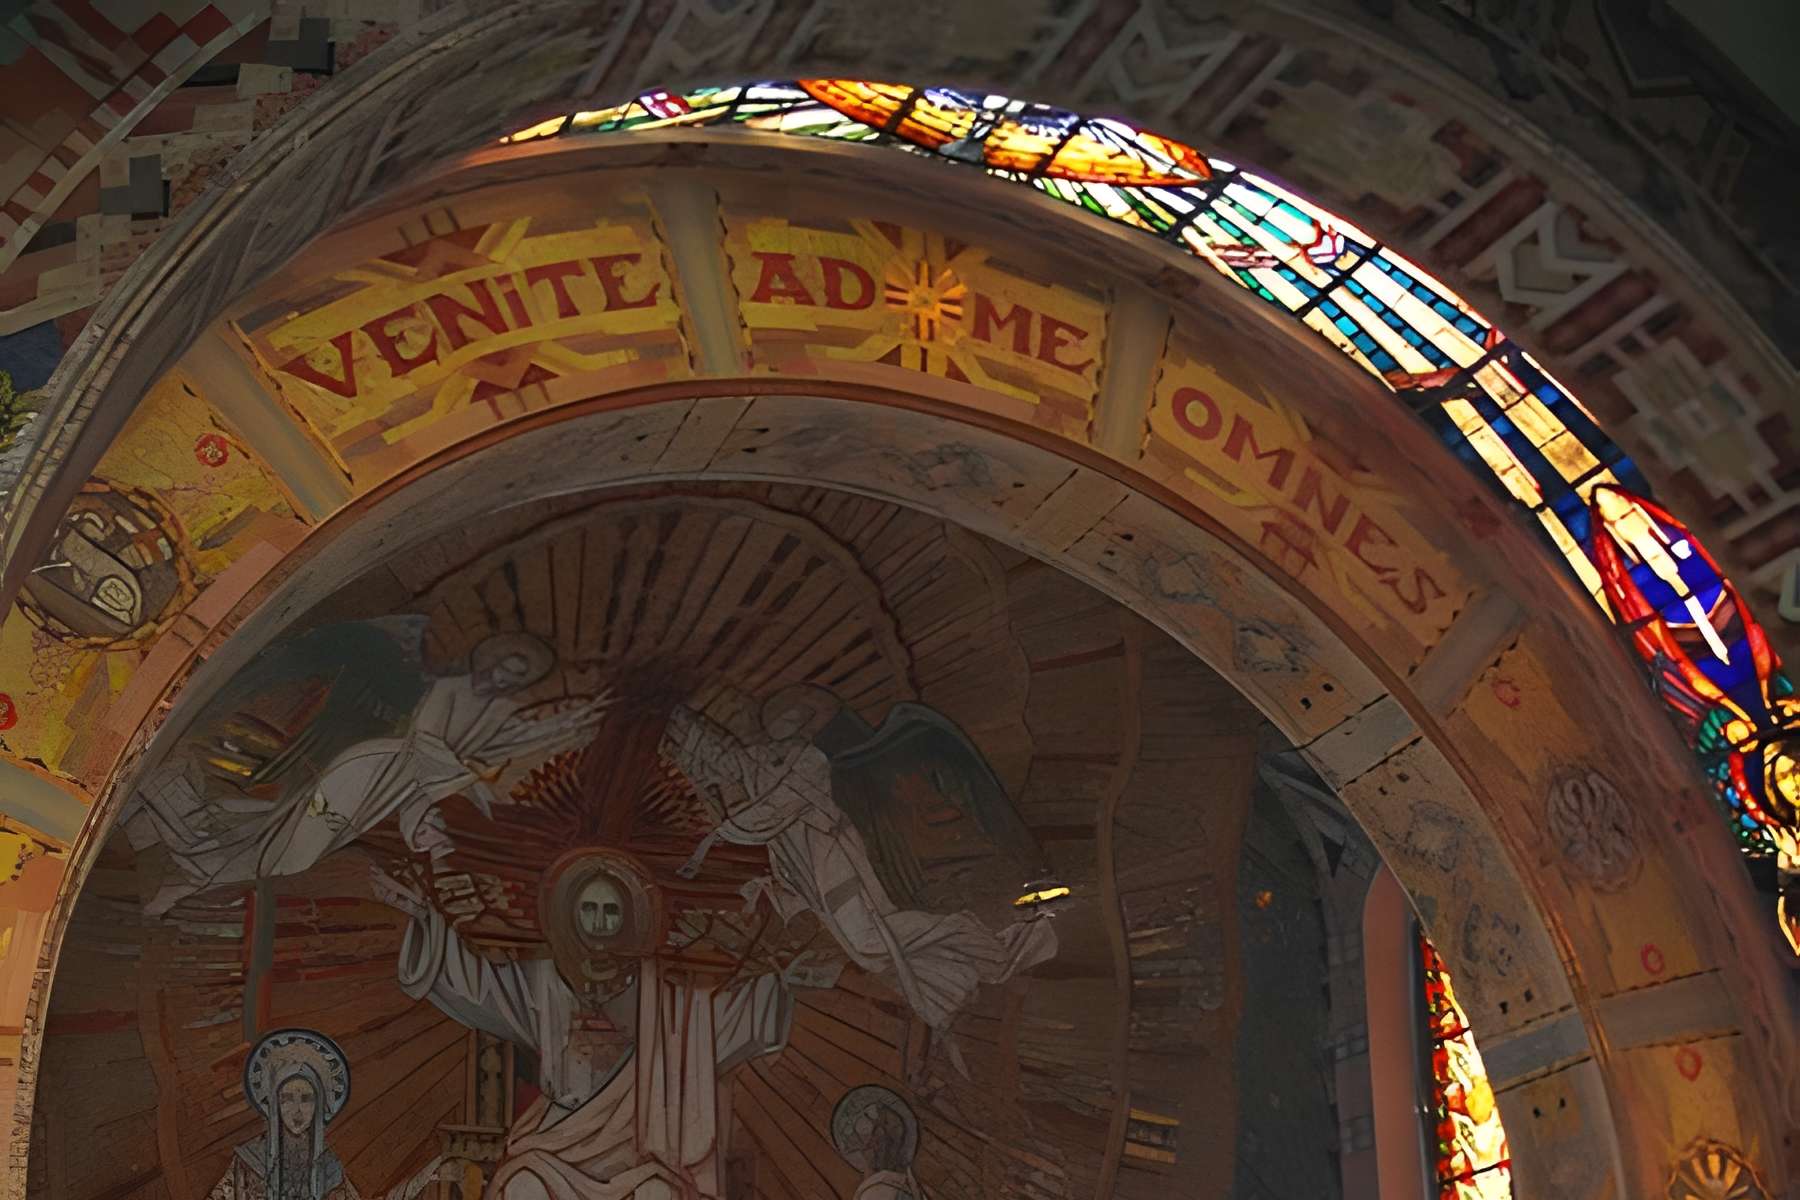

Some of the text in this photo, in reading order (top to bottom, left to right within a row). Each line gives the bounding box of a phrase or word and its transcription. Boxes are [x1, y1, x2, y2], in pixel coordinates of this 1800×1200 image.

[750, 252, 876, 311] AD
[971, 292, 1096, 376] ME
[1170, 386, 1447, 614] OMNES
